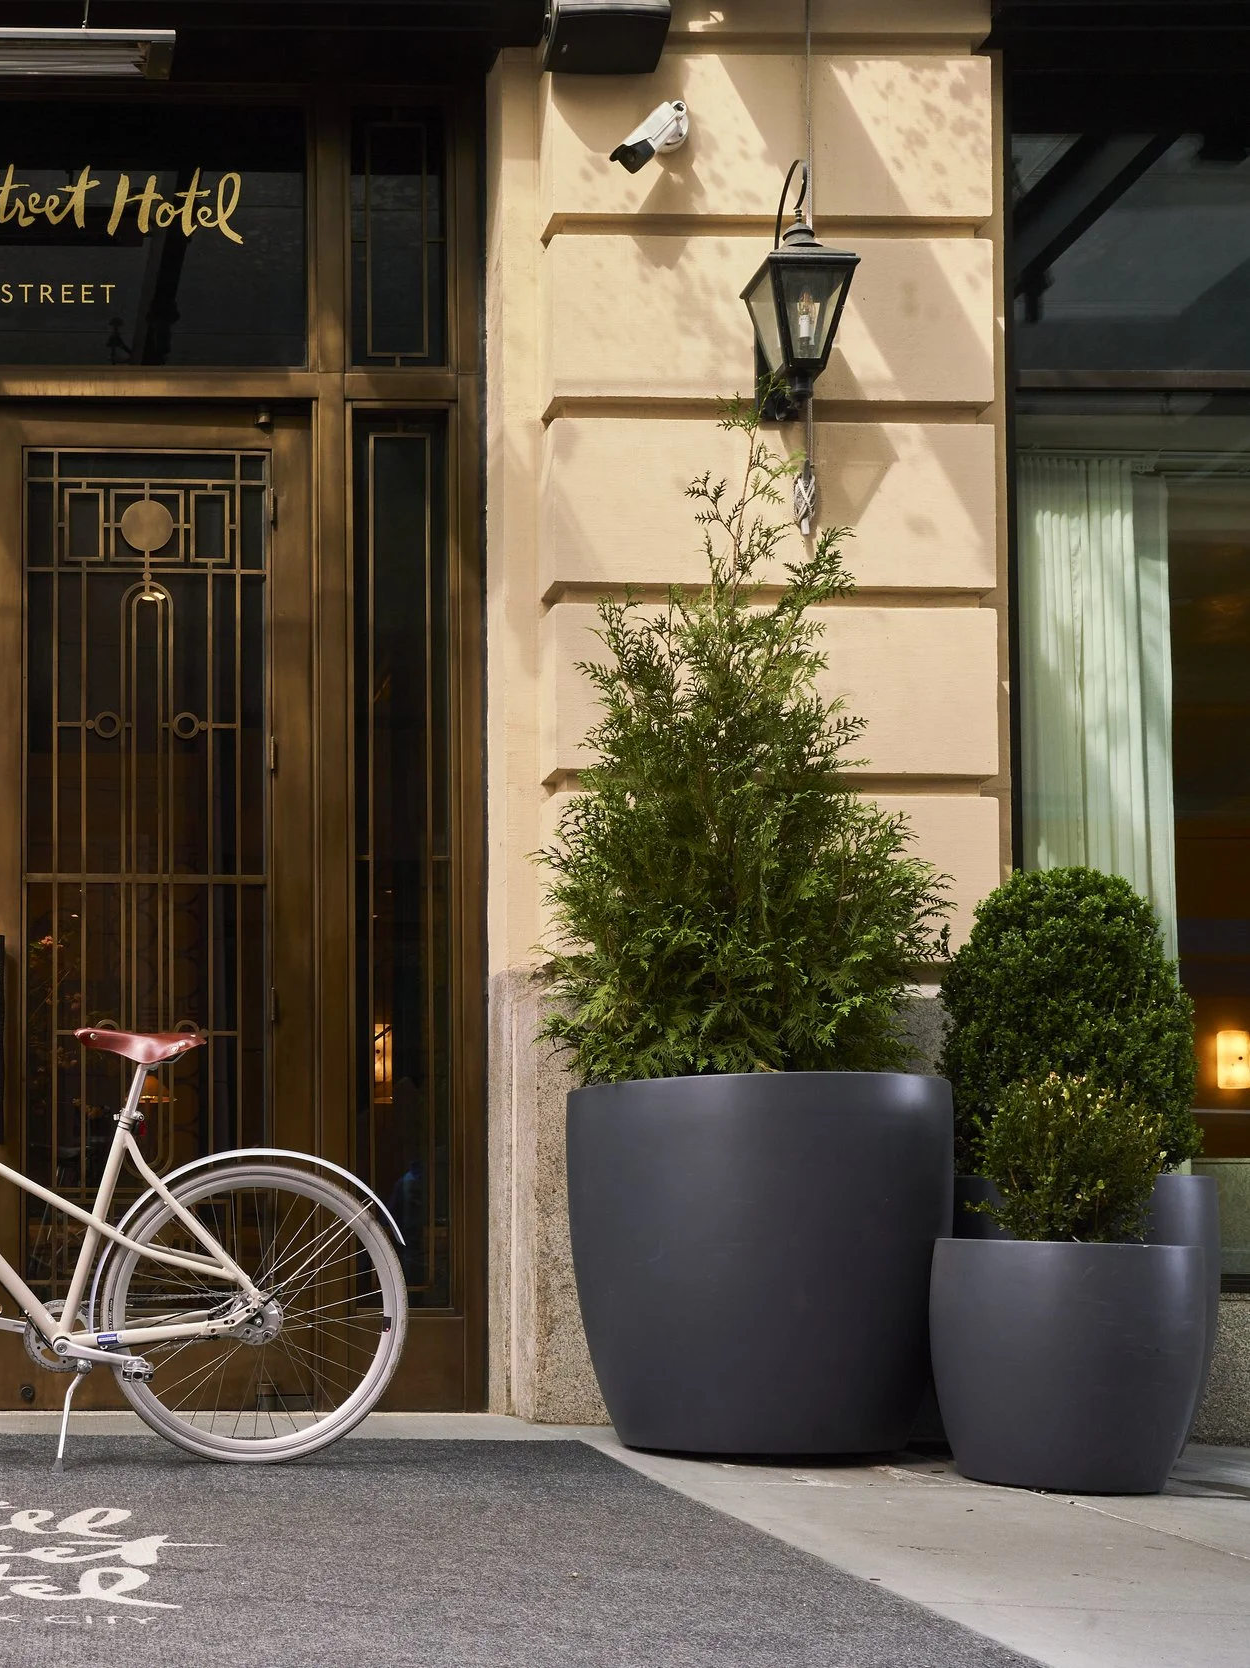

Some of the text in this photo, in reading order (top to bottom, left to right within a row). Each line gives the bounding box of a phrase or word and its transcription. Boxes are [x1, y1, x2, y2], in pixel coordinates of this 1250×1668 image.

[107, 167, 244, 245] Hotel
[0, 283, 116, 304] STREET
[43, 1614, 157, 1625] CITY
